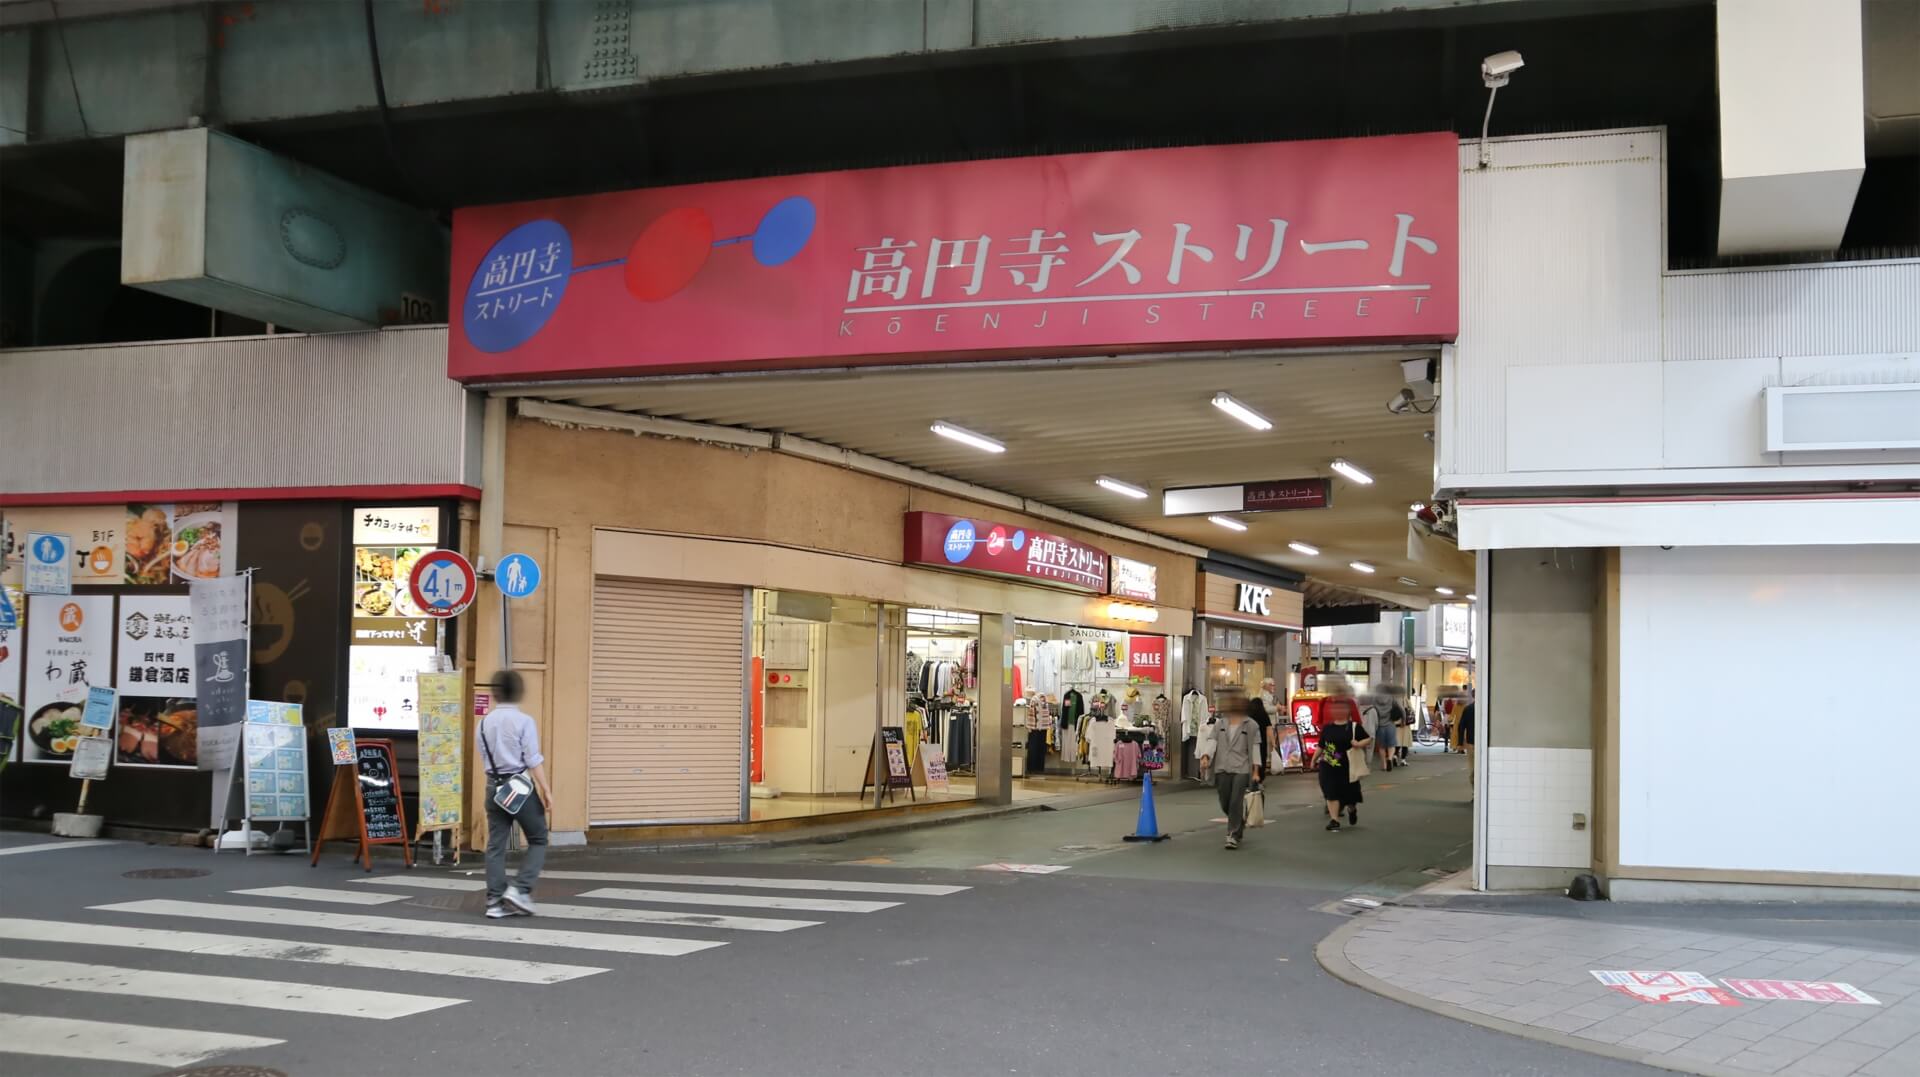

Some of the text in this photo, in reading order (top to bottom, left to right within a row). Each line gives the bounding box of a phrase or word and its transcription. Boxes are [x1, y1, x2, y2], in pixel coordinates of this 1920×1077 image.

[482, 242, 561, 289] 高円寺
[846, 213, 1438, 302] 高円寺ストリート
[475, 286, 553, 320] ストリート
[1145, 296, 1429, 324] STREET
[947, 543, 970, 551] ストリート
[950, 528, 972, 541] 高円寺
[1027, 536, 1104, 575] 高円寺ストリート
[1238, 583, 1272, 616] KFC
[144, 652, 175, 662] 四代目
[1133, 653, 1161, 664] SALE
[45, 659, 90, 687] わ蔵
